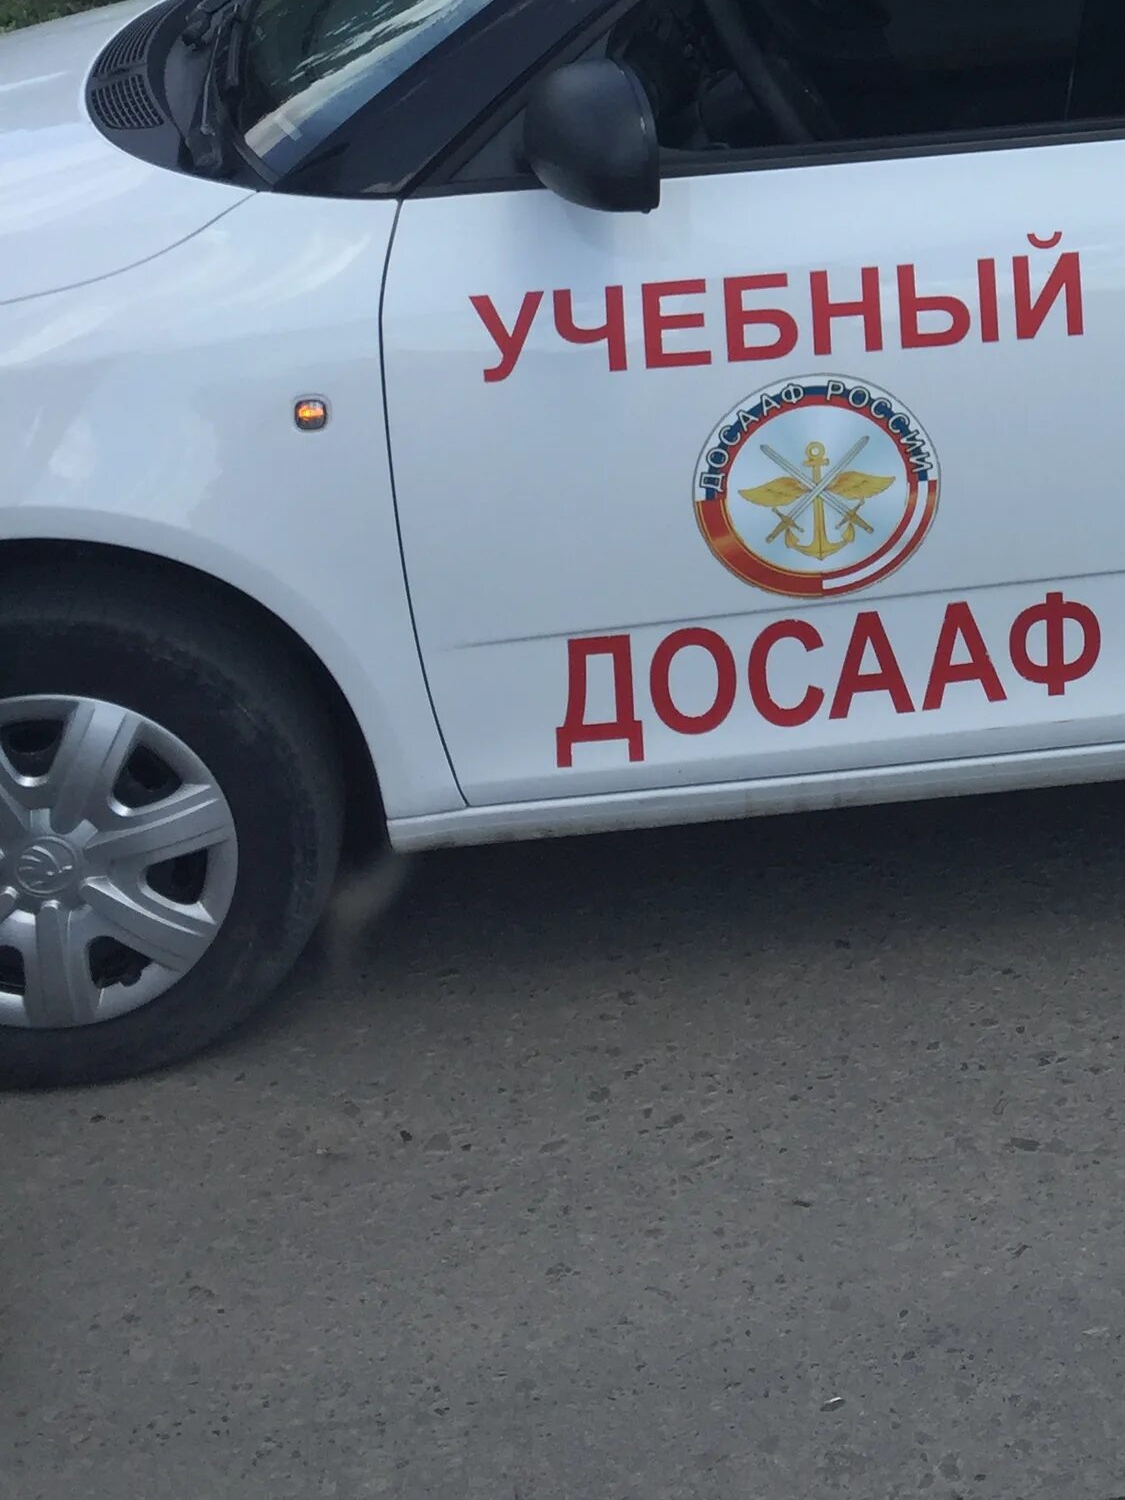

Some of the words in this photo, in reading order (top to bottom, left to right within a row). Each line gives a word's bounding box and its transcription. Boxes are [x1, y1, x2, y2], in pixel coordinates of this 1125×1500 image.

[468, 230, 1084, 383] УЧЕБНЫЙ
[699, 383, 805, 493] ДОСААФ
[825, 380, 934, 472] РОССИИ
[556, 591, 1101, 768] ДОСААФ
